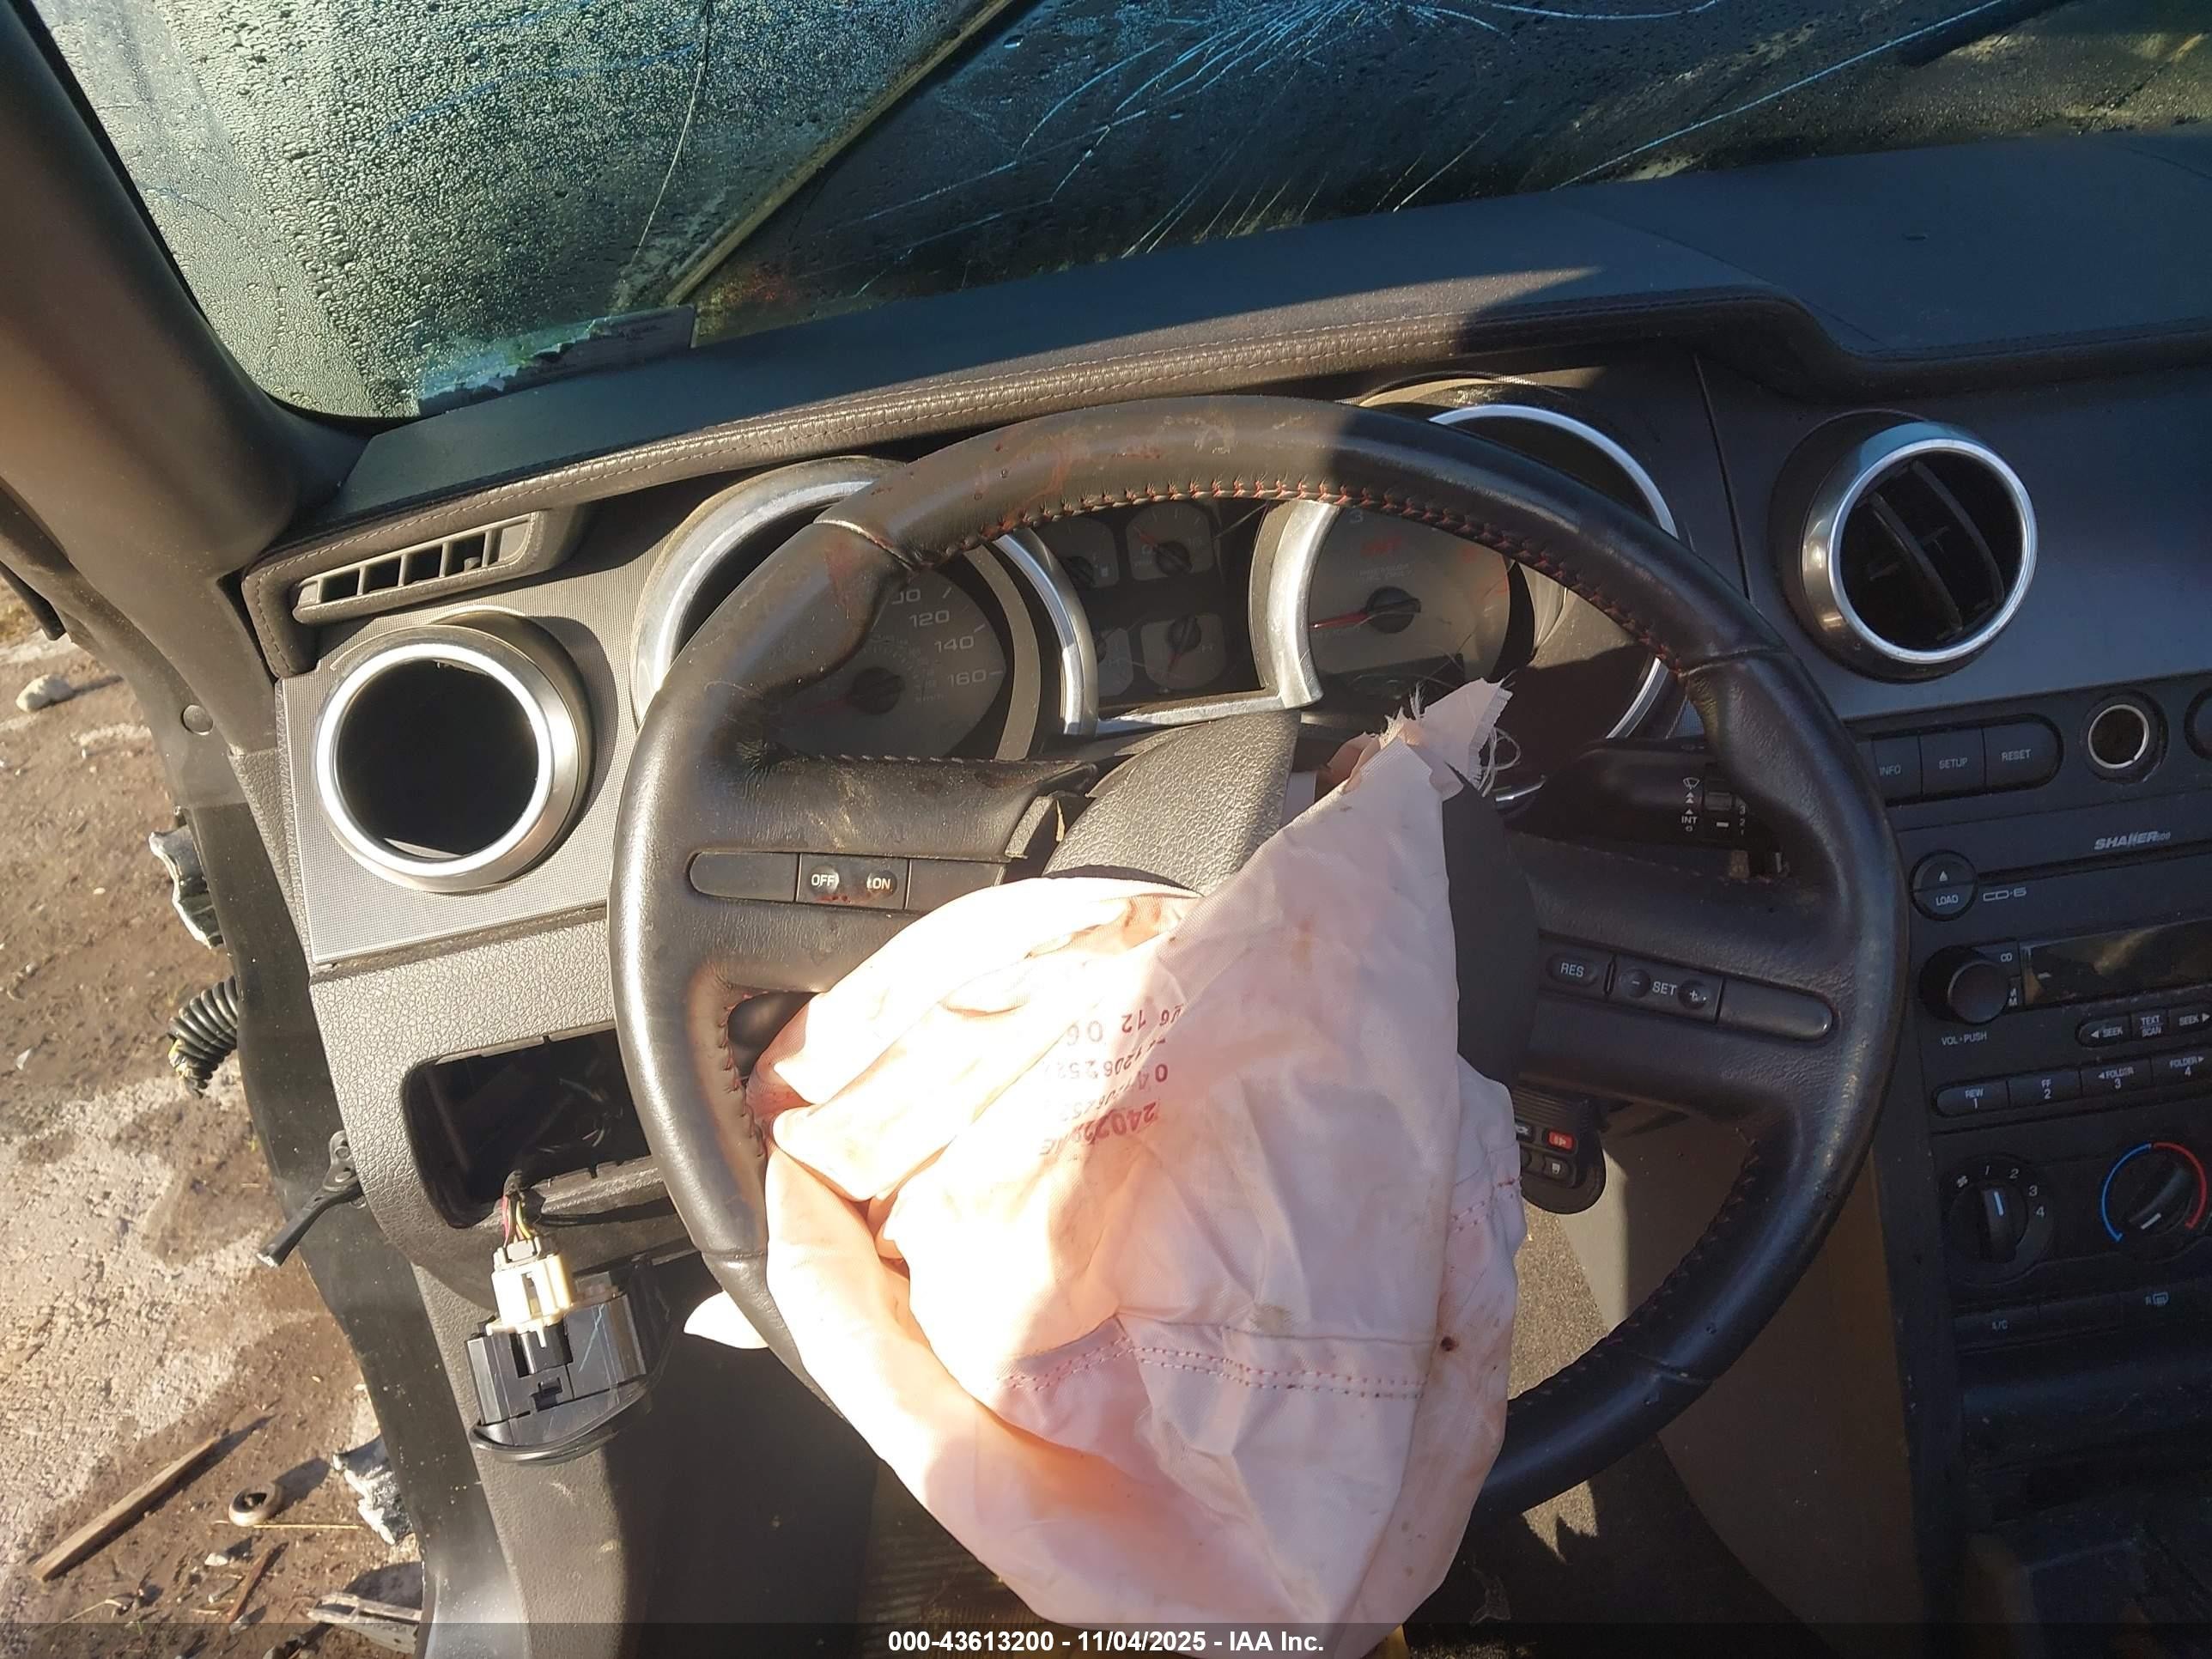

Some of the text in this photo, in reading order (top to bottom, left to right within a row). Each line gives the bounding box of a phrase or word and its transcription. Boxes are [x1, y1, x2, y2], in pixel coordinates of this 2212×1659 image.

[909, 610, 950, 628] 120
[934, 635, 974, 653] 140
[948, 669, 987, 686] 160
[2001, 749, 2031, 762] RESET
[1938, 757, 1968, 769] SETUP
[1879, 763, 1901, 776] INFO
[811, 873, 835, 888] OFF
[872, 877, 890, 890] ON
[1936, 895, 1959, 906] LOAD
[2000, 952, 2013, 963] CD
[1560, 963, 1584, 977] RES
[1652, 981, 1677, 996] SET
[1942, 1030, 1988, 1047] VOL PUSH
[2185, 1066, 2191, 1077] 4
[2041, 1079, 2052, 1089] FF
[2115, 1078, 2122, 1090] 3
[1965, 1088, 1984, 1099] REW
[2044, 1089, 2051, 1099] 2
[2009, 1168, 2020, 1180] 2
[2028, 1186, 2038, 1197] 3
[2036, 1206, 2045, 1218] 4
